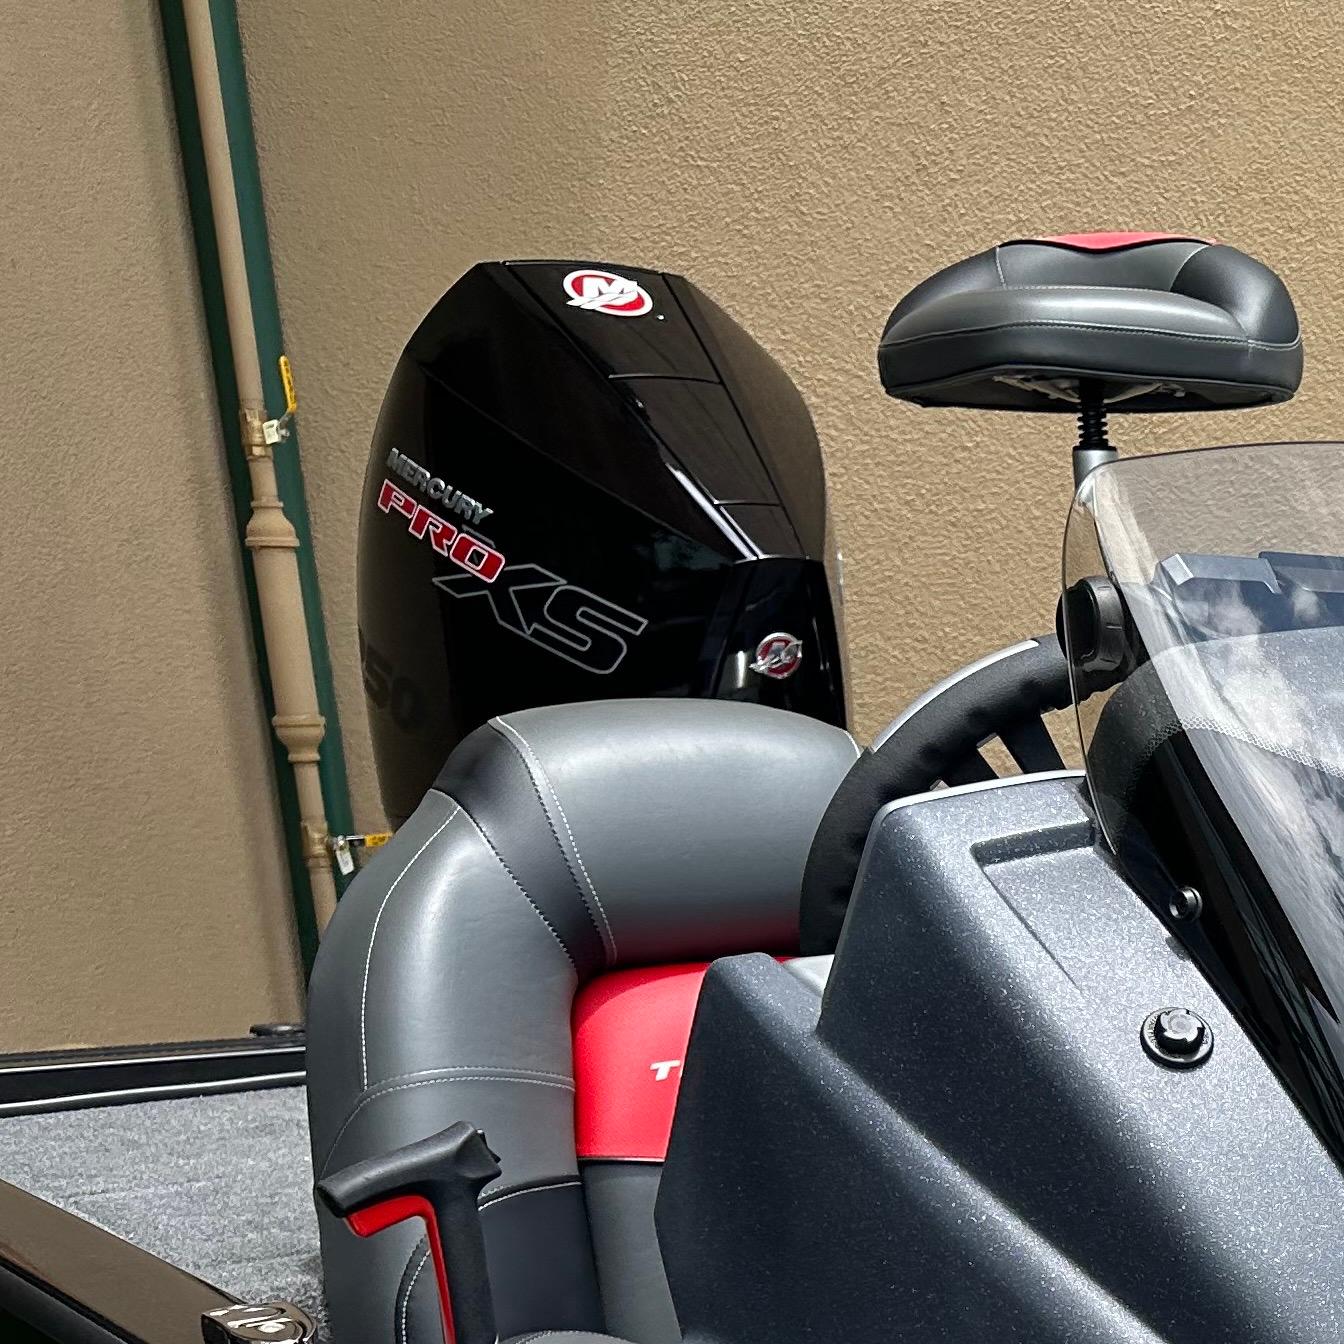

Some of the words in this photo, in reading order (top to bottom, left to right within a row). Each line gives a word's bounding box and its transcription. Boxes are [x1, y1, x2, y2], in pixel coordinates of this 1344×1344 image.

[377, 479, 505, 583] PRO
[385, 447, 494, 525] MERCURY
[432, 523, 648, 674] XS
